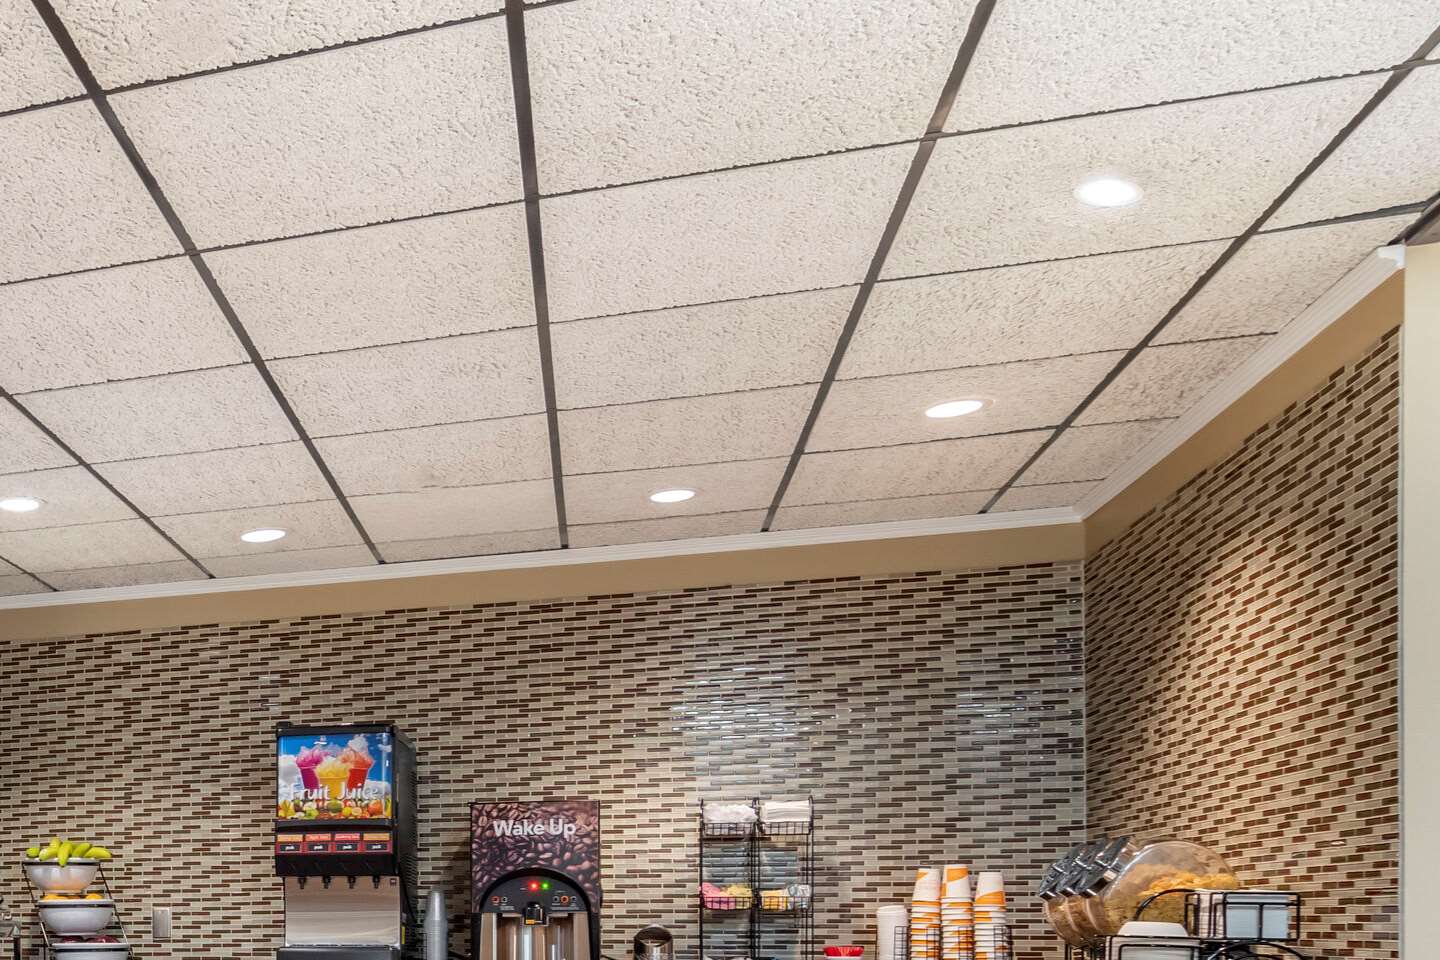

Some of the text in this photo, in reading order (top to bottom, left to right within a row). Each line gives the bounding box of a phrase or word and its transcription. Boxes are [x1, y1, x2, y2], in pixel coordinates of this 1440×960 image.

[290, 782, 379, 800] Fruit Juice
[493, 818, 577, 839] Wake Up
